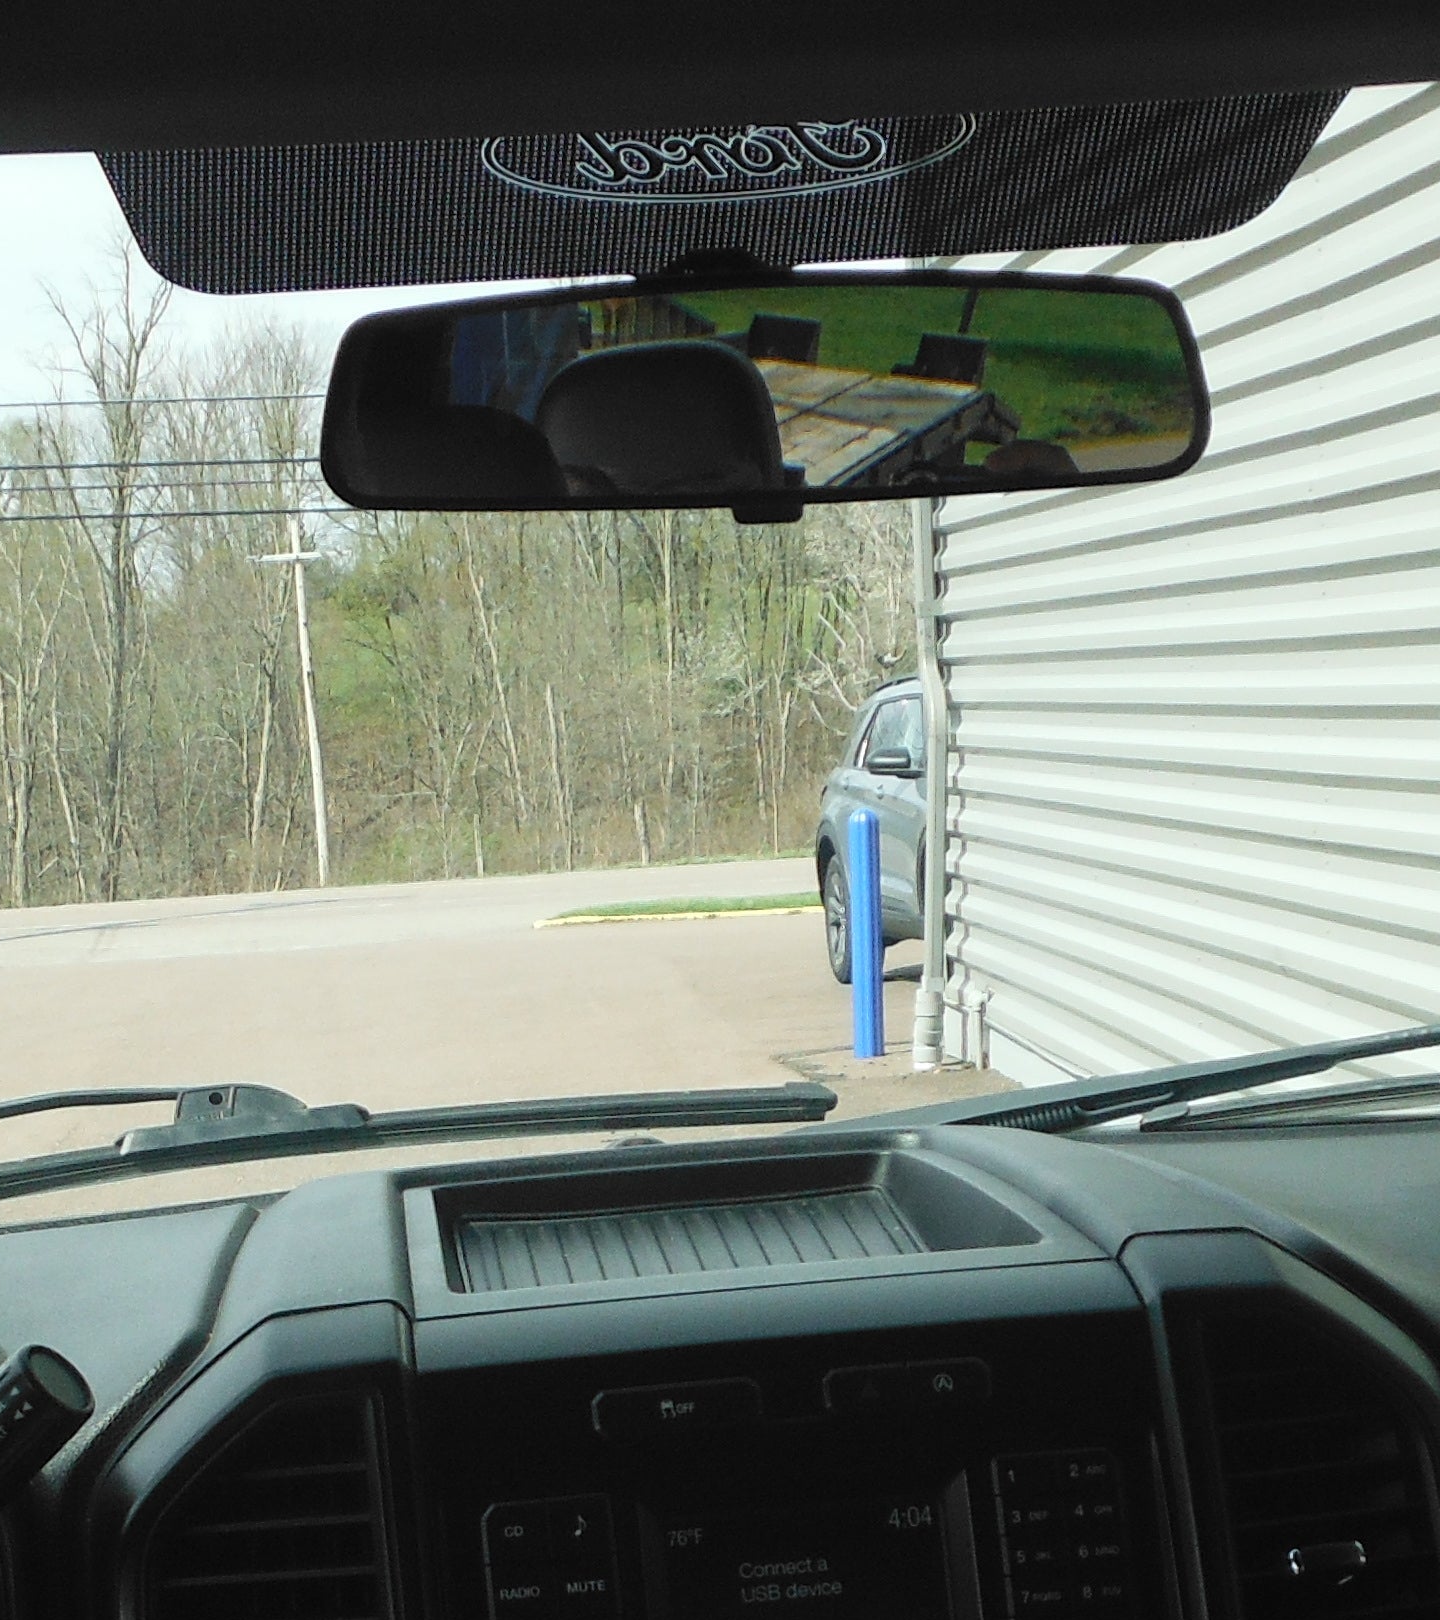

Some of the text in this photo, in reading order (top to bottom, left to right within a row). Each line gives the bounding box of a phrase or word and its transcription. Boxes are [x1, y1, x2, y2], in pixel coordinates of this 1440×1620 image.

[1069, 1463, 1079, 1478] 2
[889, 1505, 932, 1528] 4:04
[1012, 1510, 1021, 1524] 3
[1074, 1504, 1084, 1517] 4
[504, 1525, 524, 1538] CD
[1016, 1550, 1026, 1564] 5
[1079, 1545, 1089, 1559] 6
[738, 1557, 829, 1579] Connect a
[499, 1585, 541, 1600] RADIO
[566, 1579, 608, 1594] MUTE
[741, 1579, 844, 1603] USB device
[1082, 1586, 1093, 1600] 8
[1021, 1591, 1030, 1604] 7
